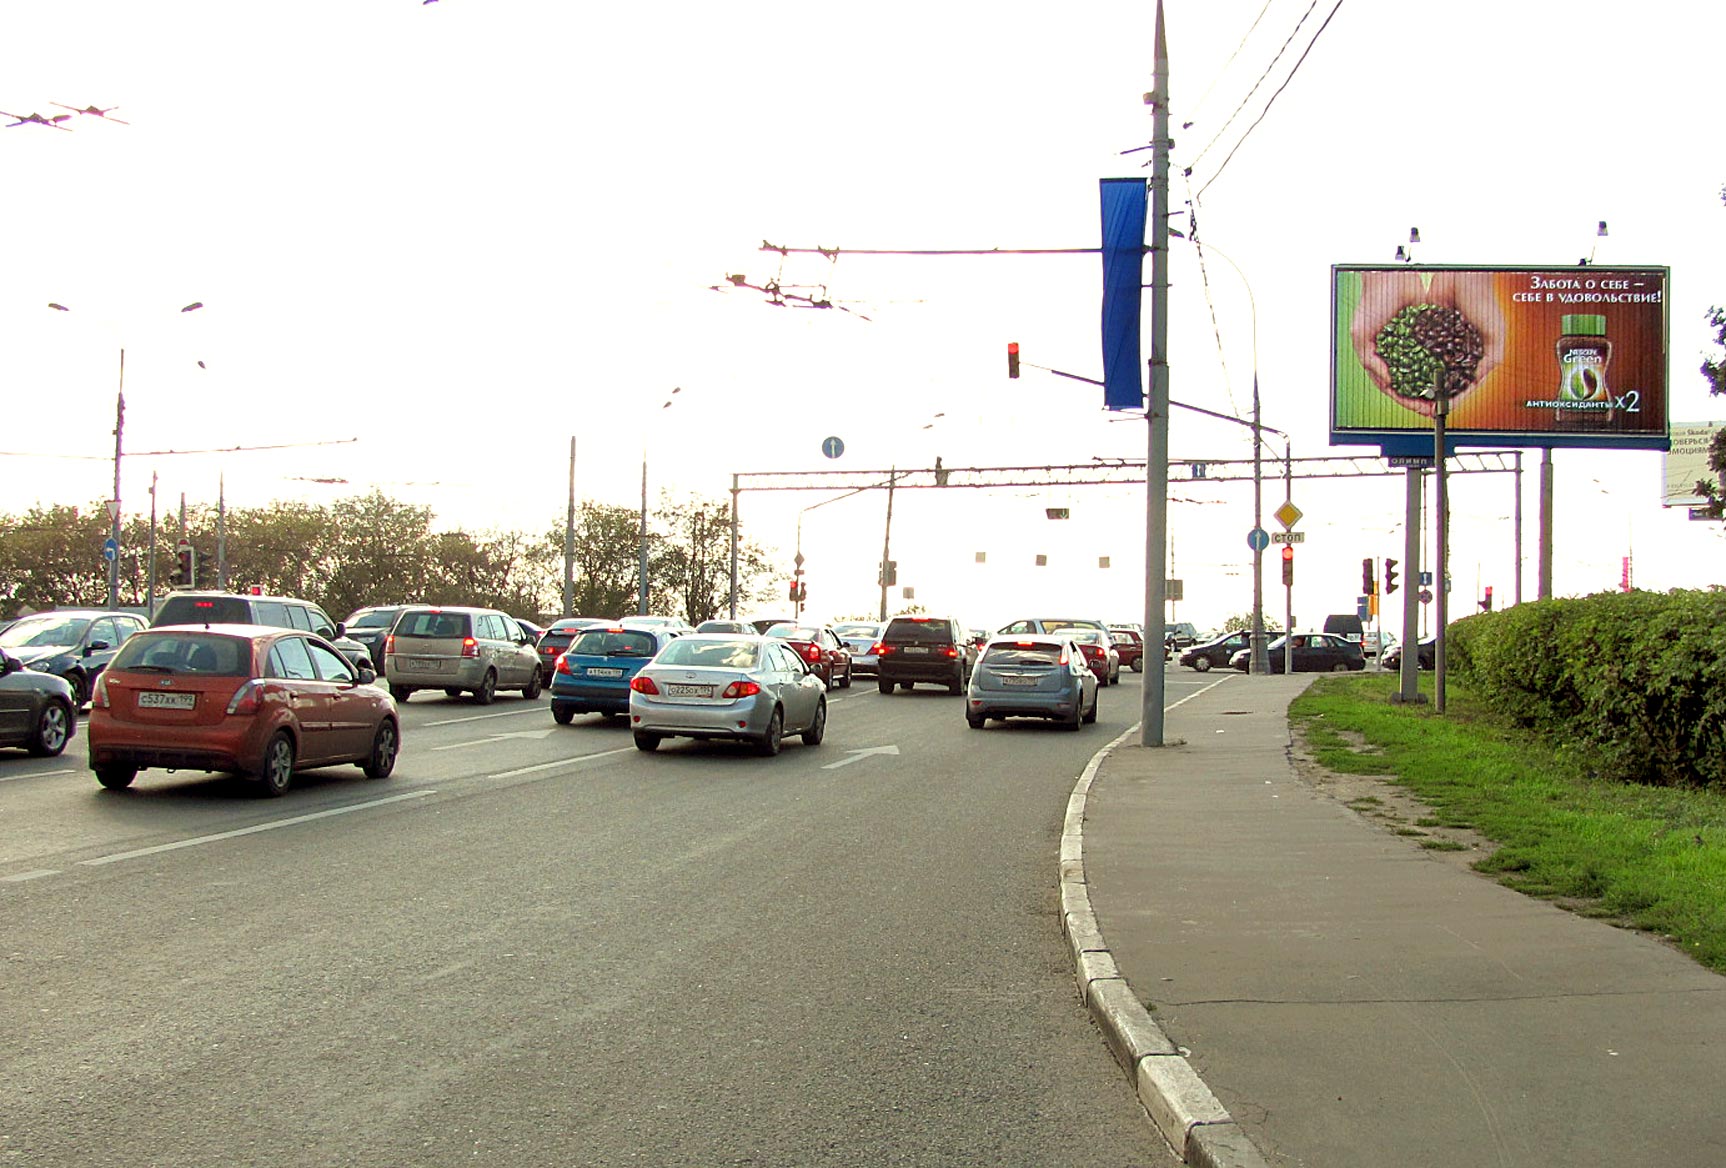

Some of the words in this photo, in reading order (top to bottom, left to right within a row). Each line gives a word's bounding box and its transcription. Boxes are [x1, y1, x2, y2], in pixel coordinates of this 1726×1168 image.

[1600, 279, 1629, 289] СЕБЕ
[1512, 292, 1541, 302] СЕБЕ
[1546, 292, 1554, 302] В
[1558, 290, 1661, 303] УДОВОЛЬСТВИЕ!
[1275, 534, 1301, 542] СТОП
